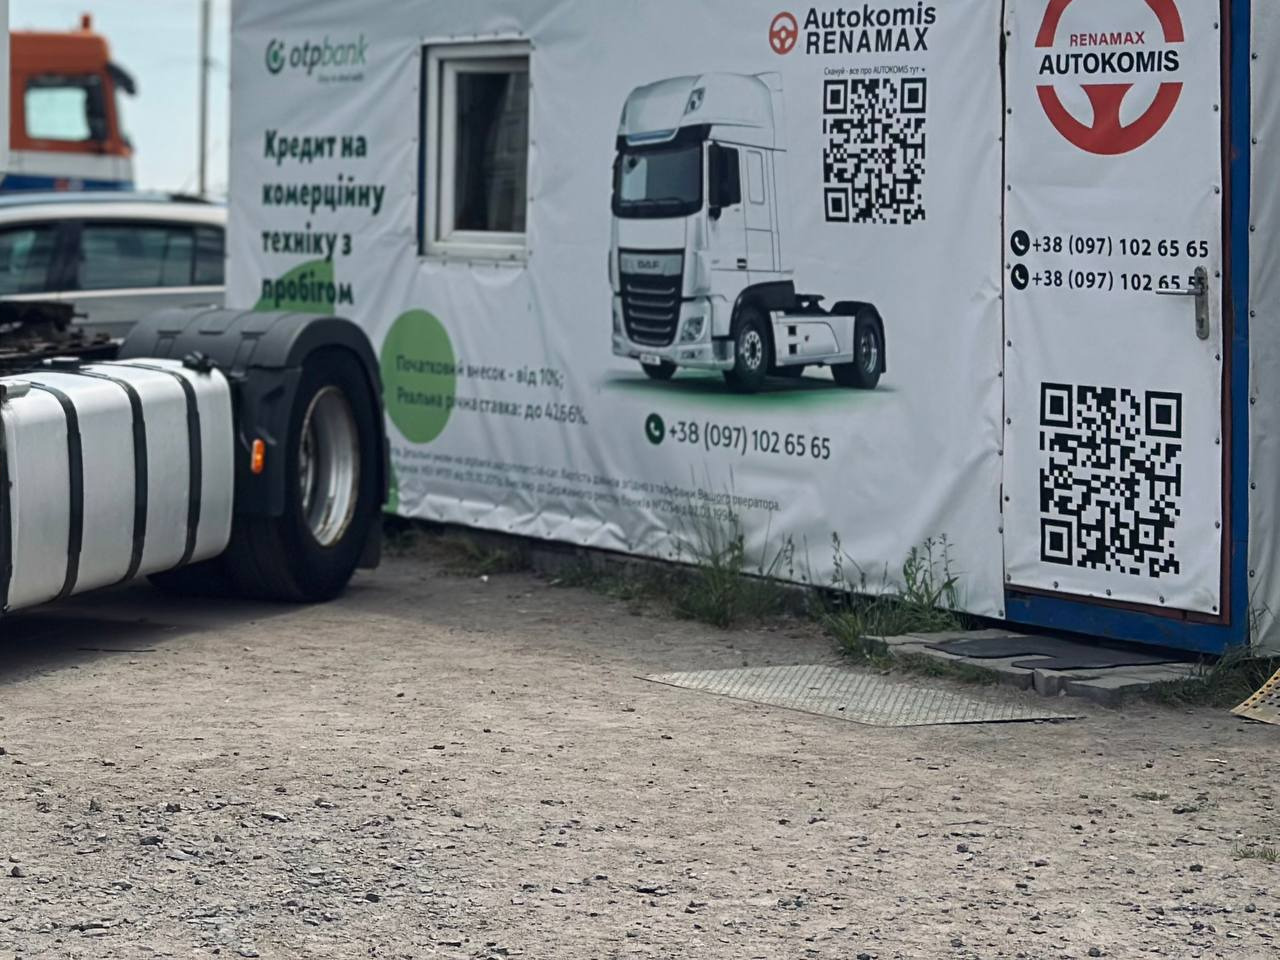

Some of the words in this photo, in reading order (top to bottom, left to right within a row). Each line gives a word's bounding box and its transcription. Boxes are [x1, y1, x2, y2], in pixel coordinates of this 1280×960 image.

[803, 1, 937, 30] Autokomis
[806, 27, 929, 55] RENAMAX
[1069, 30, 1146, 48] RENAMAX
[873, 64, 909, 75] AUTOKOMIS
[1037, 49, 1180, 76] AUTOKOMIS
[263, 129, 337, 167] Кредит
[341, 135, 367, 159] на
[262, 172, 385, 216] комерційну
[262, 221, 337, 263] техніку
[342, 233, 352, 256] з
[1032, 235, 1063, 253] +38
[1068, 234, 1113, 257] (097)
[1119, 238, 1152, 256] 102
[1157, 239, 1180, 257] 65
[1186, 239, 1209, 258] 65
[261, 269, 354, 309] пробігом
[1032, 270, 1063, 287] +38
[1068, 269, 1114, 291] (097)
[1120, 273, 1153, 291] 102
[1158, 274, 1181, 290] 65
[524, 403, 542, 421] до
[669, 421, 700, 444] +38
[704, 422, 748, 456] (097)
[752, 429, 780, 454] 102
[784, 433, 806, 457] 65
[810, 436, 831, 460] 65
